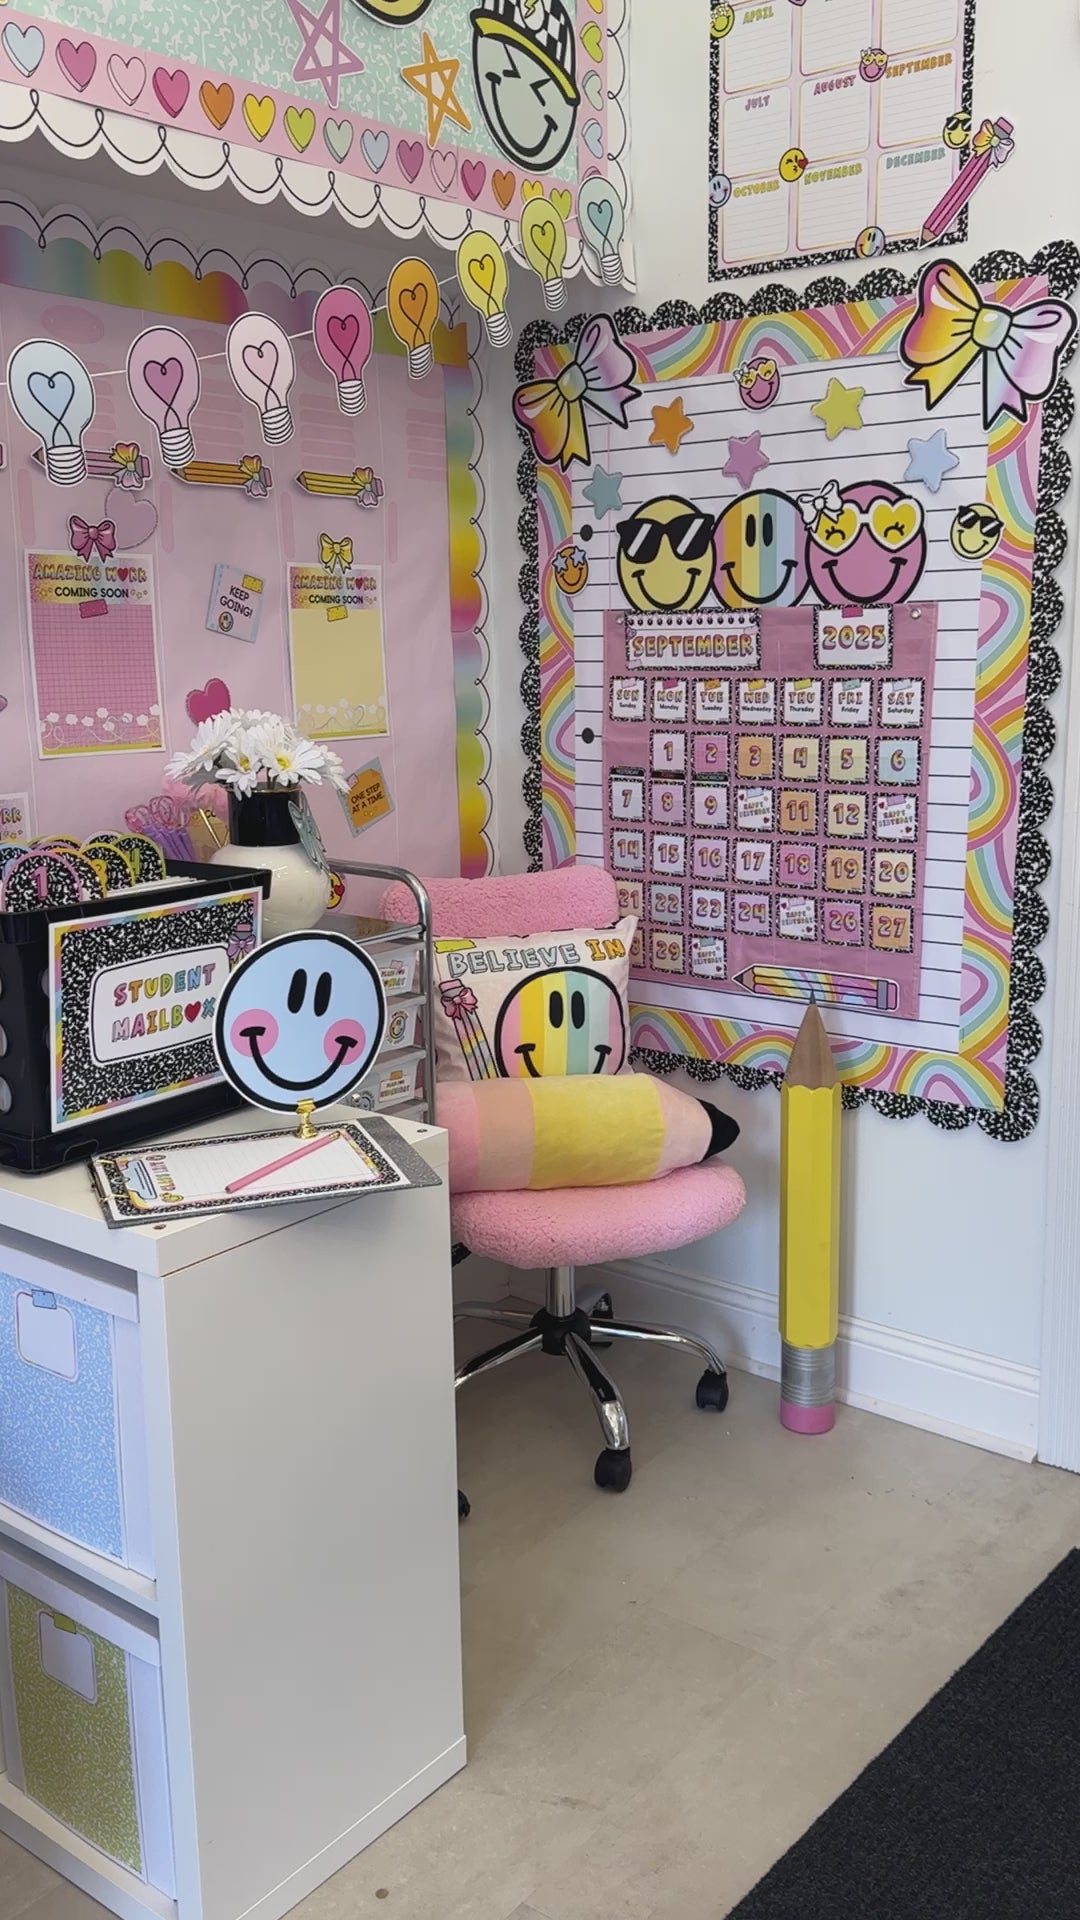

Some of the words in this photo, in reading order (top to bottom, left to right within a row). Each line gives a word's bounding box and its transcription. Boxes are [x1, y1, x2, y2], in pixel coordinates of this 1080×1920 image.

[743, 6, 774, 24] APRIL
[886, 53, 953, 79] SEPTEMBER
[812, 75, 856, 96] AUGUST
[745, 95, 770, 111] JULY
[886, 147, 946, 169] DECEMBER
[804, 163, 862, 185] NOVEMBER
[733, 180, 780, 198] OCTOBER
[33, 563, 101, 581] AMAZING
[292, 574, 343, 590] AMAZING
[54, 586, 98, 598] COMING
[100, 587, 129, 599] SOON
[229, 585, 250, 601] KEEP
[308, 594, 341, 604] COMING
[342, 595, 364, 604] SOON
[219, 595, 253, 619] GOING!
[632, 634, 753, 658] SEPTEMBER
[822, 625, 887, 650] 2025
[616, 689, 639, 701] SUN
[657, 690, 683, 702] MON
[700, 691, 724, 704] TUE
[744, 691, 770, 704] WED
[788, 691, 815, 705] THU
[838, 691, 863, 705] FRI
[887, 691, 915, 705] SAT
[619, 702, 637, 710] Sunday
[789, 705, 815, 713] Thursday
[841, 706, 860, 714] Friday
[887, 706, 914, 715] Saturday
[664, 741, 674, 761] 1
[705, 743, 718, 763] 2
[749, 745, 762, 766] 3
[793, 747, 808, 768] 4
[840, 748, 854, 770] 5
[890, 749, 906, 771] 6
[351, 791, 365, 804] ONE
[366, 782, 380, 796] STEP
[621, 789, 633, 808] 7
[661, 792, 674, 812] 8
[704, 795, 718, 815] 9
[352, 803, 360, 814] AT
[362, 801, 367, 809] A
[786, 800, 810, 822] 11
[833, 803, 860, 825] 12
[617, 839, 640, 858] 14
[658, 843, 680, 863] 15
[698, 847, 722, 868] 16
[741, 852, 765, 871] 17
[785, 853, 811, 875] 18
[831, 857, 859, 879] 19
[879, 861, 909, 883] 20
[32, 867, 48, 900] 1
[618, 889, 640, 909] 21
[655, 893, 679, 914] 22
[696, 897, 722, 918] 23
[738, 902, 766, 923] 24
[829, 910, 857, 932] 26
[878, 916, 906, 938] 27
[447, 943, 580, 978] BELIEVE
[585, 938, 626, 962] IN
[656, 940, 680, 961] 29
[114, 963, 216, 1007] STUDENT
